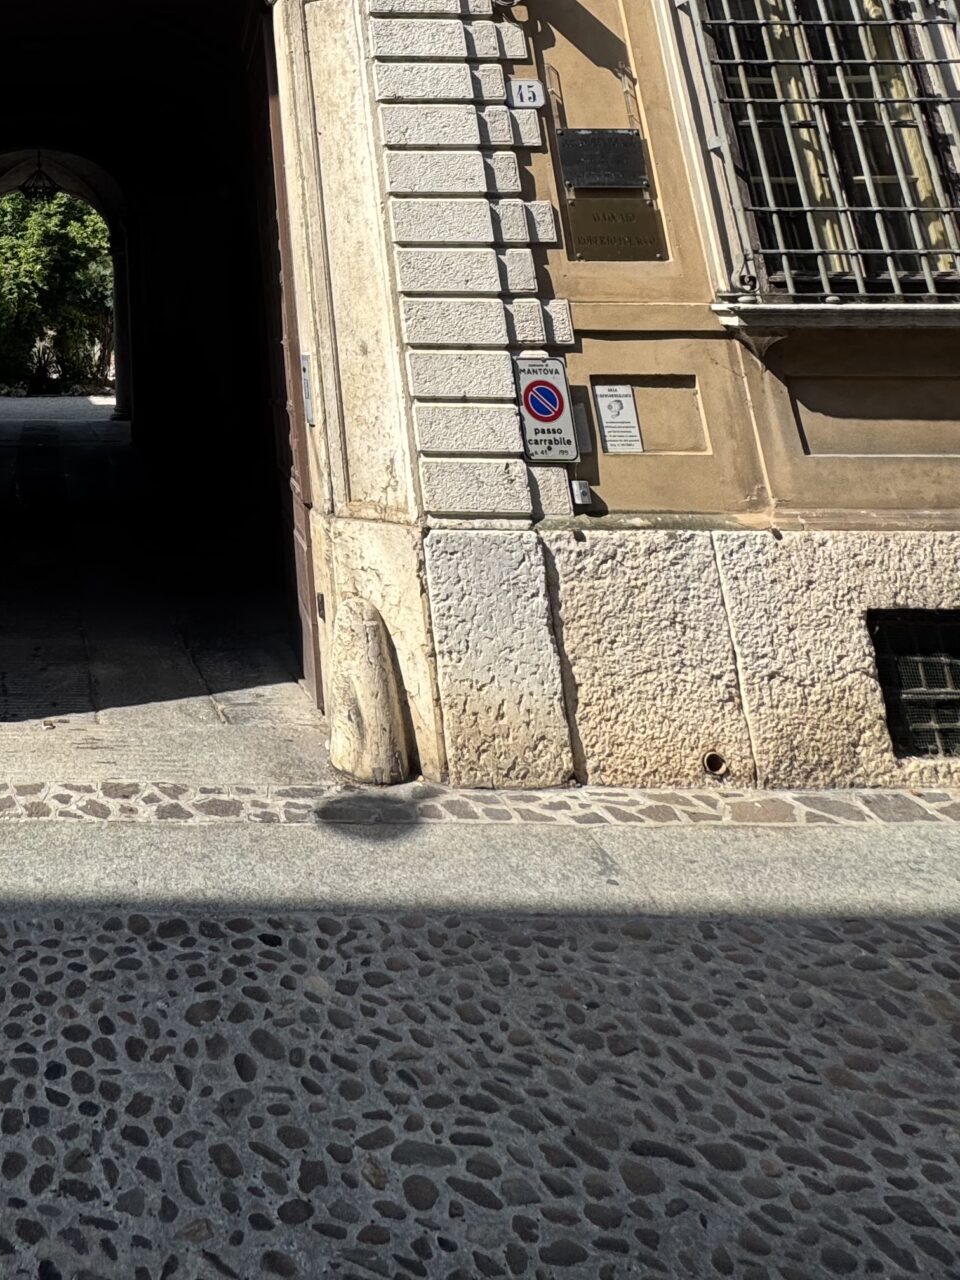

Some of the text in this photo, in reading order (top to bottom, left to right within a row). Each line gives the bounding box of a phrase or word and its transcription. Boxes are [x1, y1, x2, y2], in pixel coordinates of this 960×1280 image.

[517, 84, 537, 103] 15
[534, 427, 563, 435] passo
[528, 437, 572, 446] carrabile
